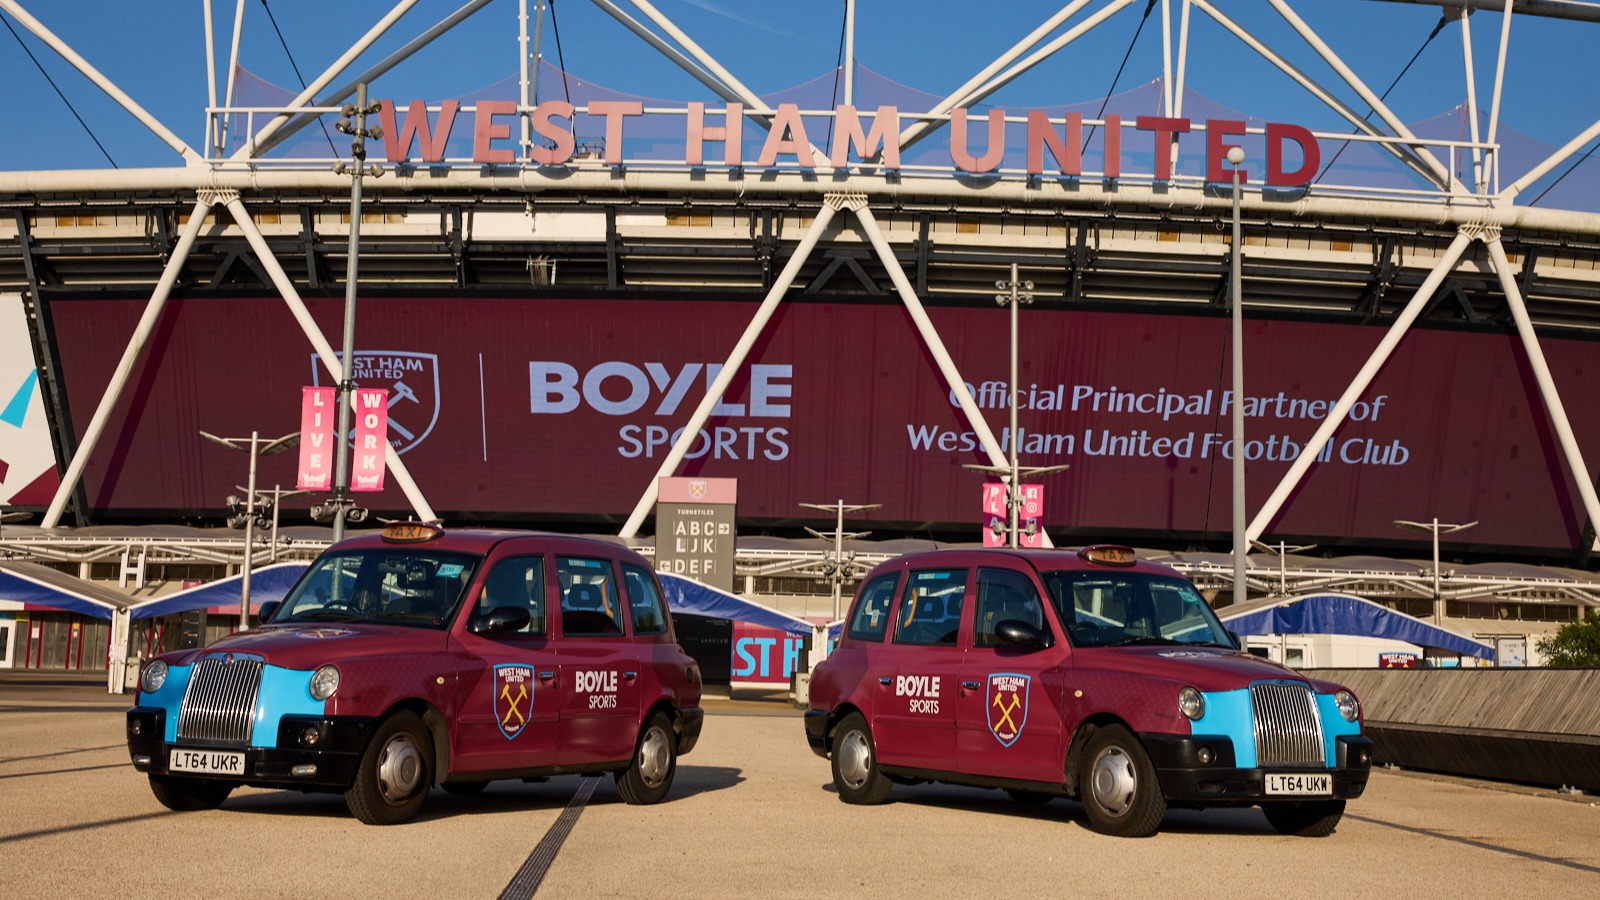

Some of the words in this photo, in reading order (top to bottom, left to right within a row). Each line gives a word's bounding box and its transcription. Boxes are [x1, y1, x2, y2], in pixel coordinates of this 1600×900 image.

[378, 99, 643, 166] WEST
[686, 101, 900, 169] HAM
[949, 107, 1321, 187] UNITED
[379, 357, 424, 372] HAM
[529, 361, 793, 418] BOYLE
[949, 381, 1064, 411] Official
[1071, 384, 1213, 421] Principal
[1348, 395, 1388, 422] of
[309, 392, 325, 468] LIVE
[362, 393, 382, 470] WORK
[617, 424, 790, 461] SPORTS
[1001, 427, 1075, 455] Ham
[1083, 428, 1195, 459] United
[1200, 433, 1335, 463] Footbll
[1339, 437, 1410, 466] Club
[389, 526, 422, 537] TAXI
[733, 637, 776, 677] ST
[499, 667, 515, 679] WEST
[516, 667, 530, 677] HAM
[505, 675, 524, 683] UNITED
[575, 670, 617, 693] BOYLE
[992, 677, 1009, 686] WEST
[1009, 677, 1024, 688] HAM
[896, 675, 940, 698] BOYLE
[998, 684, 1017, 692] UNITED
[589, 695, 617, 709] SPORTS
[909, 699, 939, 714] SPORTS
[175, 752, 207, 769] LT64
[211, 754, 239, 771] UKR
[1271, 776, 1303, 792] LT64
[1306, 776, 1327, 792] UKW
